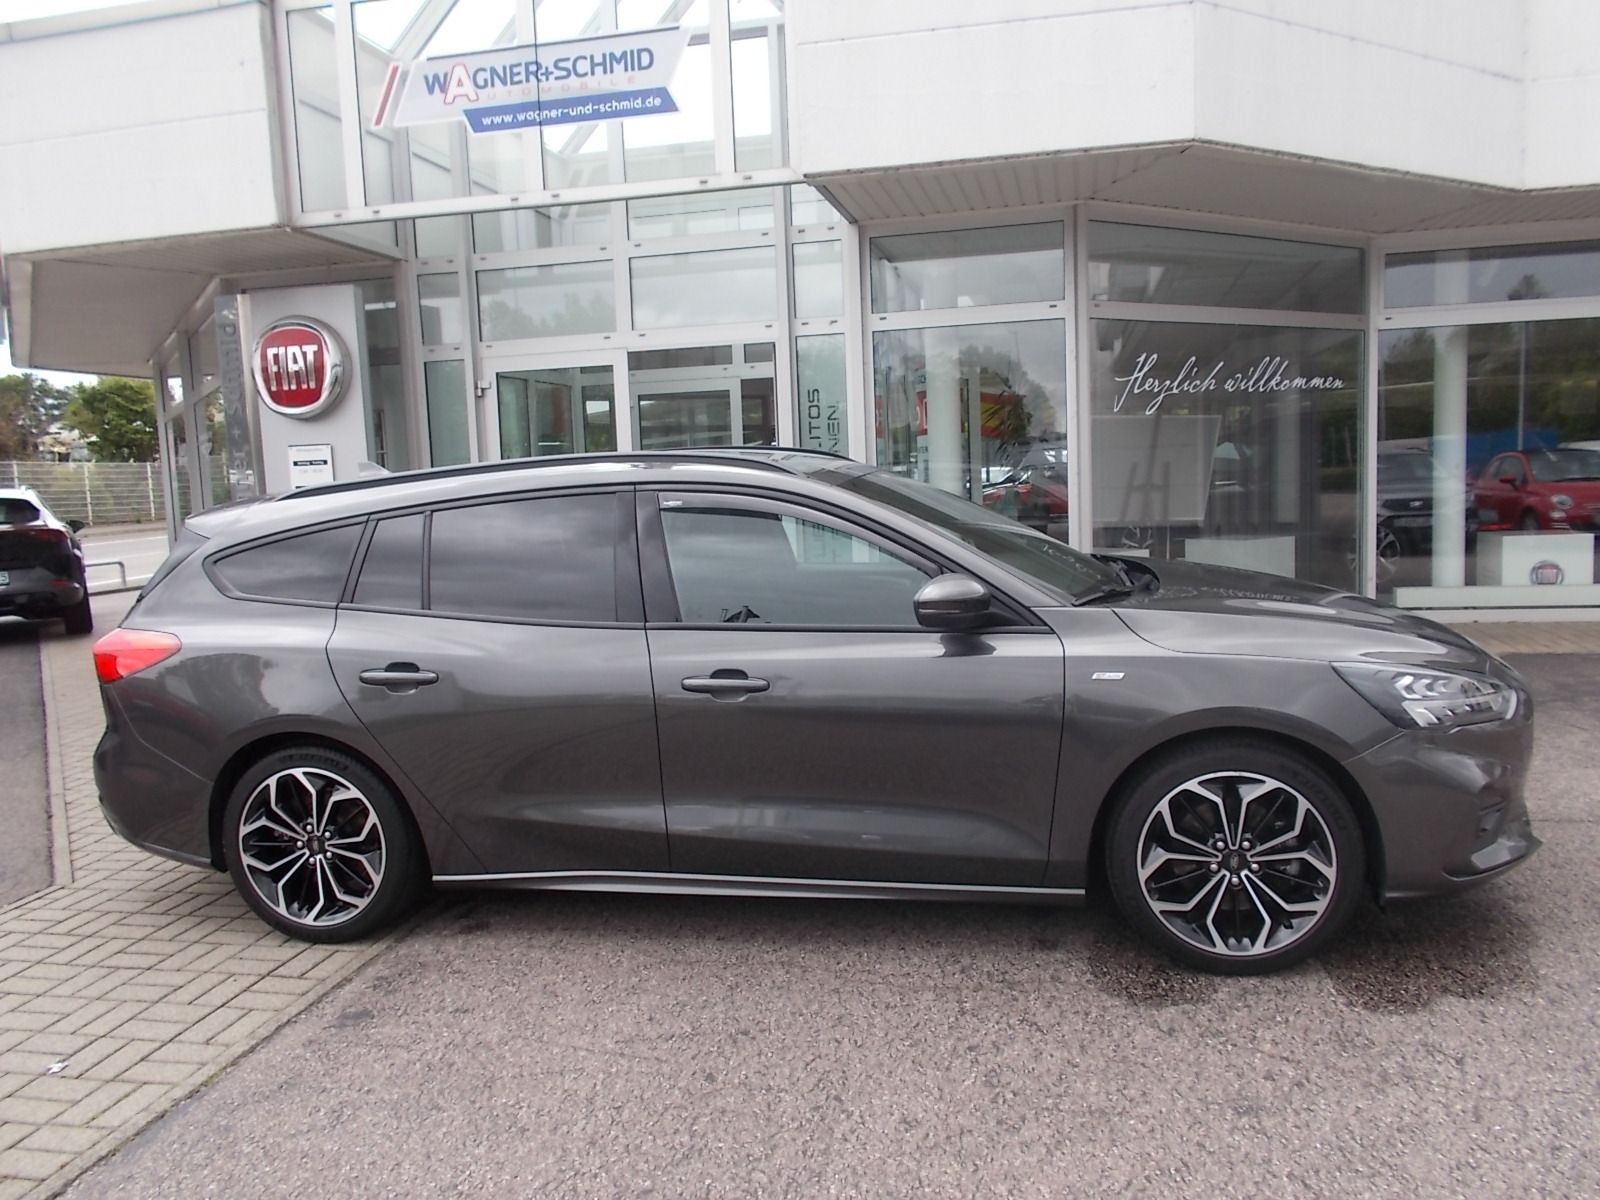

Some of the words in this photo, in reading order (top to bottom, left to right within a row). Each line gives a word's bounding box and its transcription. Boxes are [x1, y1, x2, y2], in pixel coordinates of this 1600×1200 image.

[480, 95, 663, 126] www.wagner-und-schmid.de
[266, 344, 318, 392] FIAT
[1113, 352, 1225, 415] Herzlich
[1223, 356, 1345, 394] willkommen
